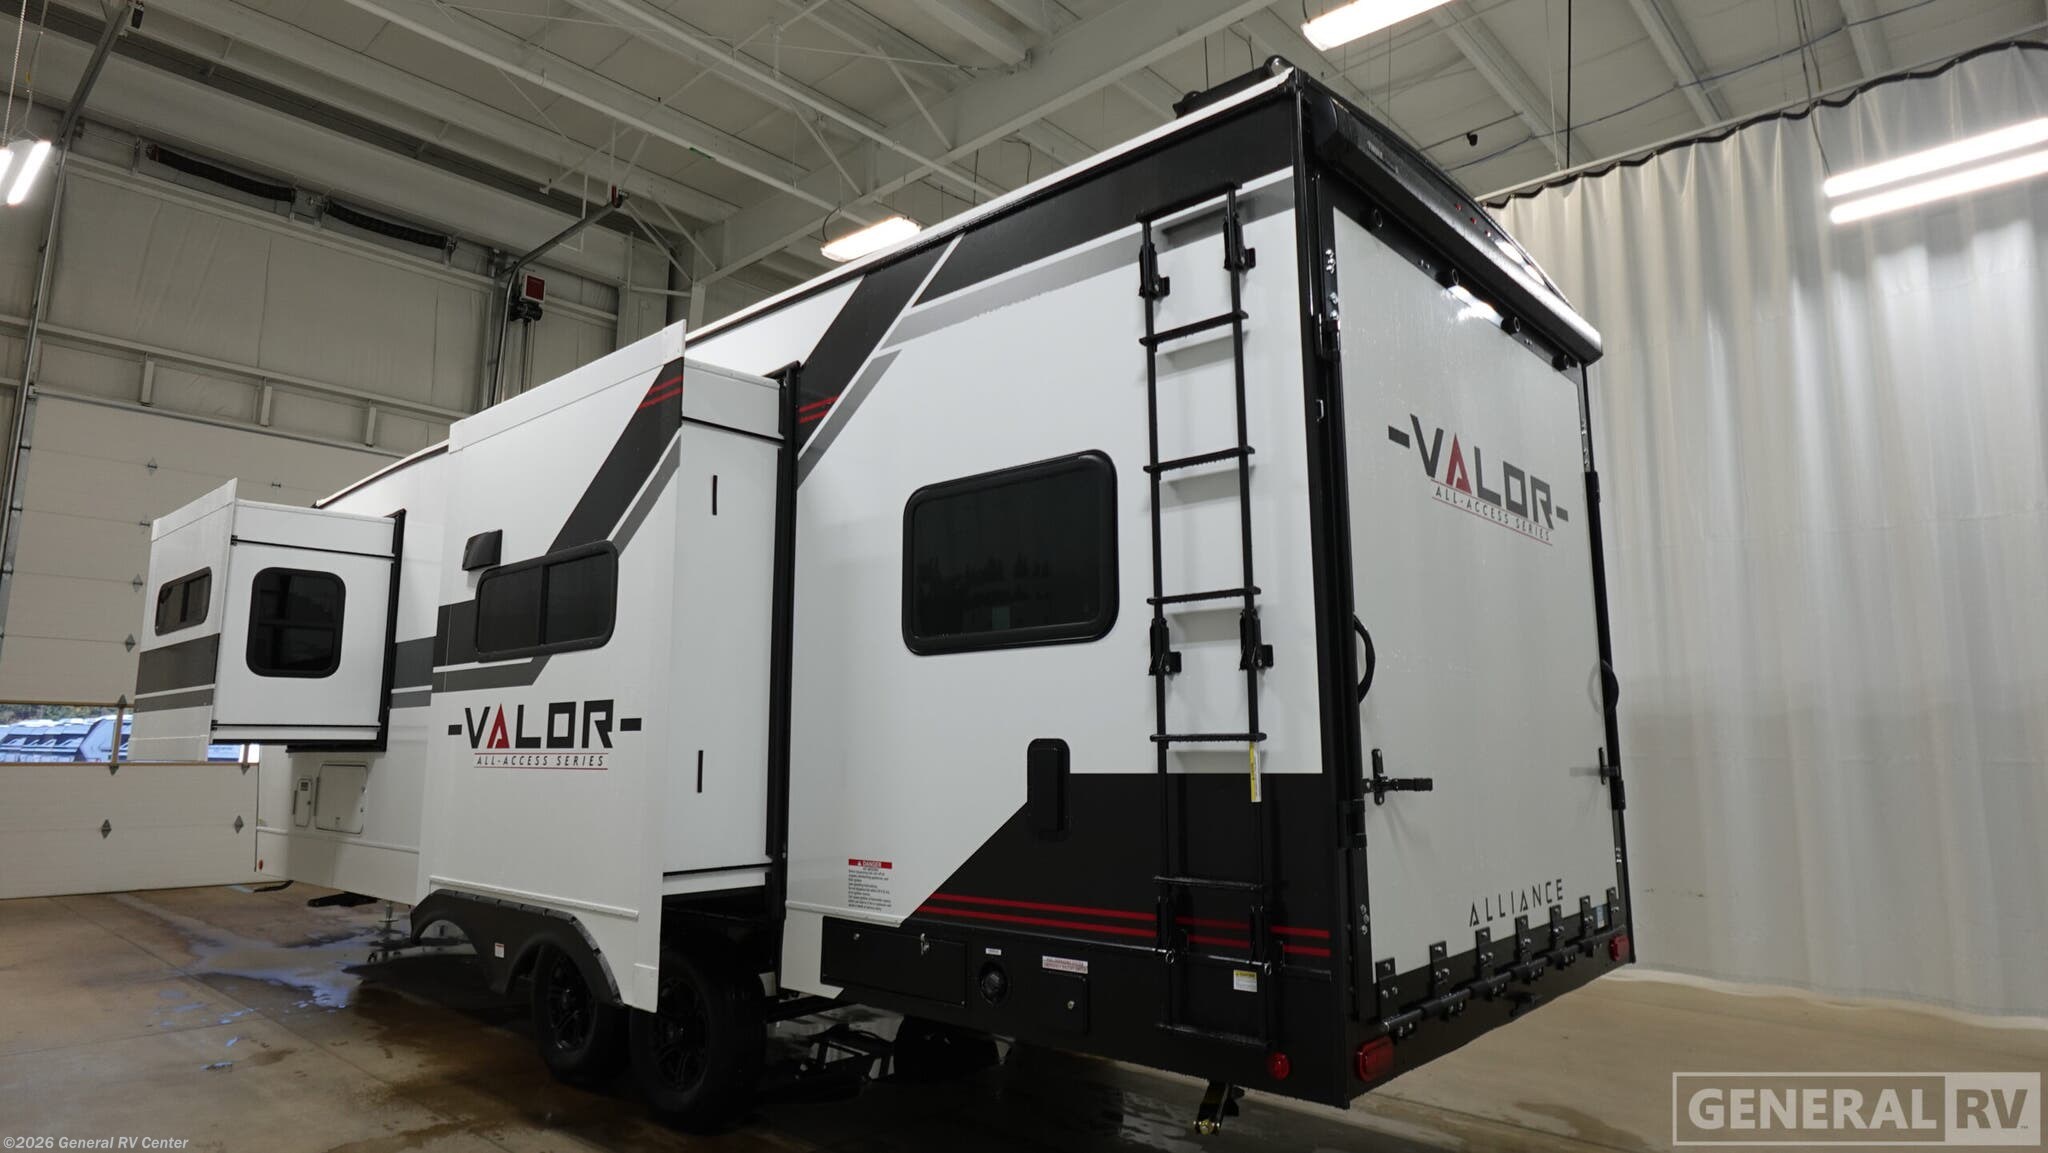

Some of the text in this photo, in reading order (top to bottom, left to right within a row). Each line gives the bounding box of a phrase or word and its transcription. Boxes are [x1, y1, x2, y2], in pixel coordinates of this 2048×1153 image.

[1435, 486, 1550, 542] ALL-ACCESS SERIES
[477, 755, 604, 767] ALL-ACCESS SERIES
[1469, 878, 1563, 927] ALLIANCE
